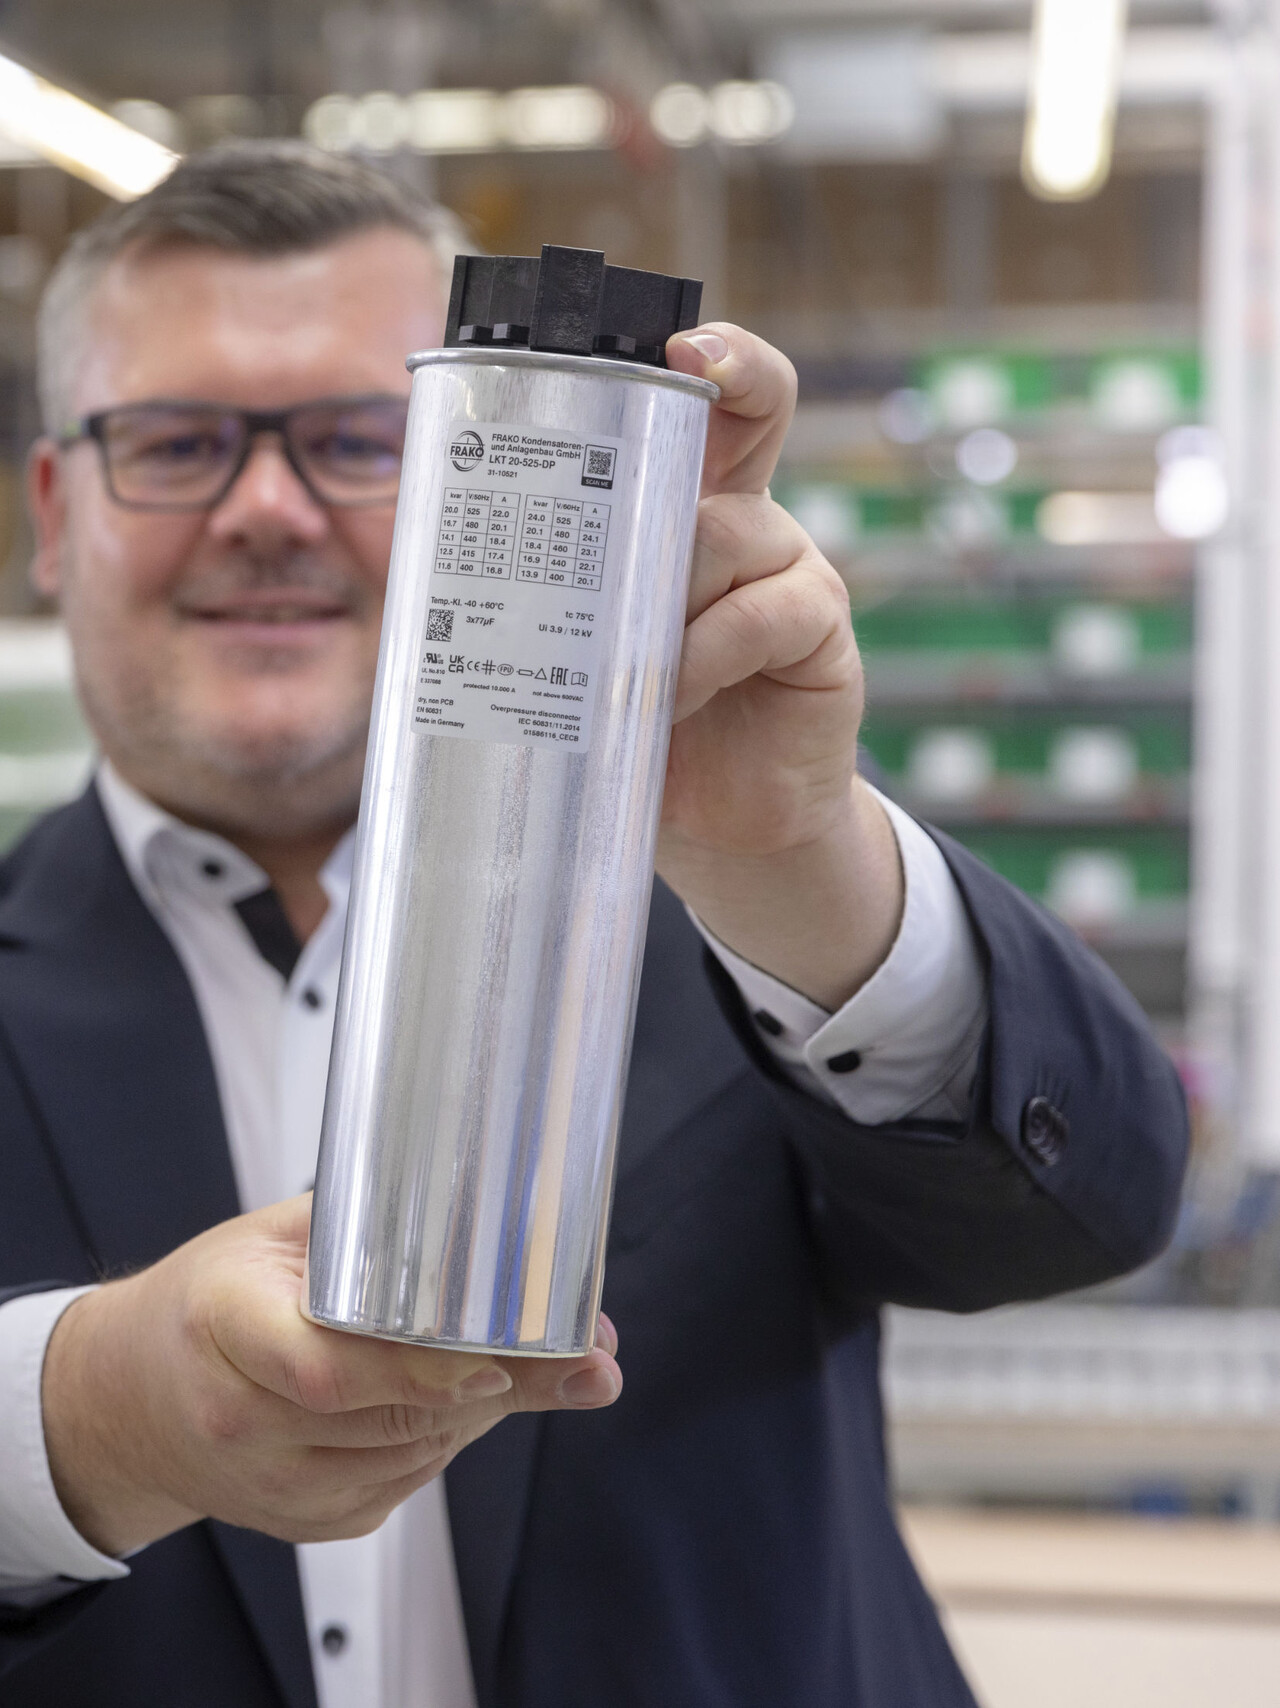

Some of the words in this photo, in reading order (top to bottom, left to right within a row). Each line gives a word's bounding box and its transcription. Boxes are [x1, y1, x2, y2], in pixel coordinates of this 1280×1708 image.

[492, 434, 519, 443] FRAKO
[521, 436, 584, 450] Kondensatoren-
[450, 446, 484, 458] FRAKO
[507, 445, 554, 457] Anlagenbau
[556, 449, 581, 460] GmbH
[489, 455, 506, 464] LKT
[508, 457, 556, 469] 20-525-DP
[488, 469, 517, 478] 31-10521
[584, 521, 601, 529] 26.4
[526, 527, 542, 535] 20.1
[583, 534, 599, 542] 24.1
[581, 548, 597, 556] 23.1
[579, 563, 595, 571] 22.1
[577, 577, 593, 585] 20.1
[480, 602, 504, 610] +60°C
[466, 616, 495, 626] 3x77µF
[575, 612, 594, 622] 75°C
[538, 624, 547, 632] Ui
[550, 625, 562, 634] 3.9
[570, 628, 580, 636] 12
[582, 629, 592, 638] kV
[450, 655, 465, 664] UK
[448, 664, 464, 673] CA
[467, 660, 481, 671] CE
[500, 664, 512, 673] FPU
[490, 704, 536, 715] Overpressure
[538, 710, 581, 721] disconnector
[438, 719, 464, 728] Germany
[532, 720, 580, 731] 60831/11.2014
